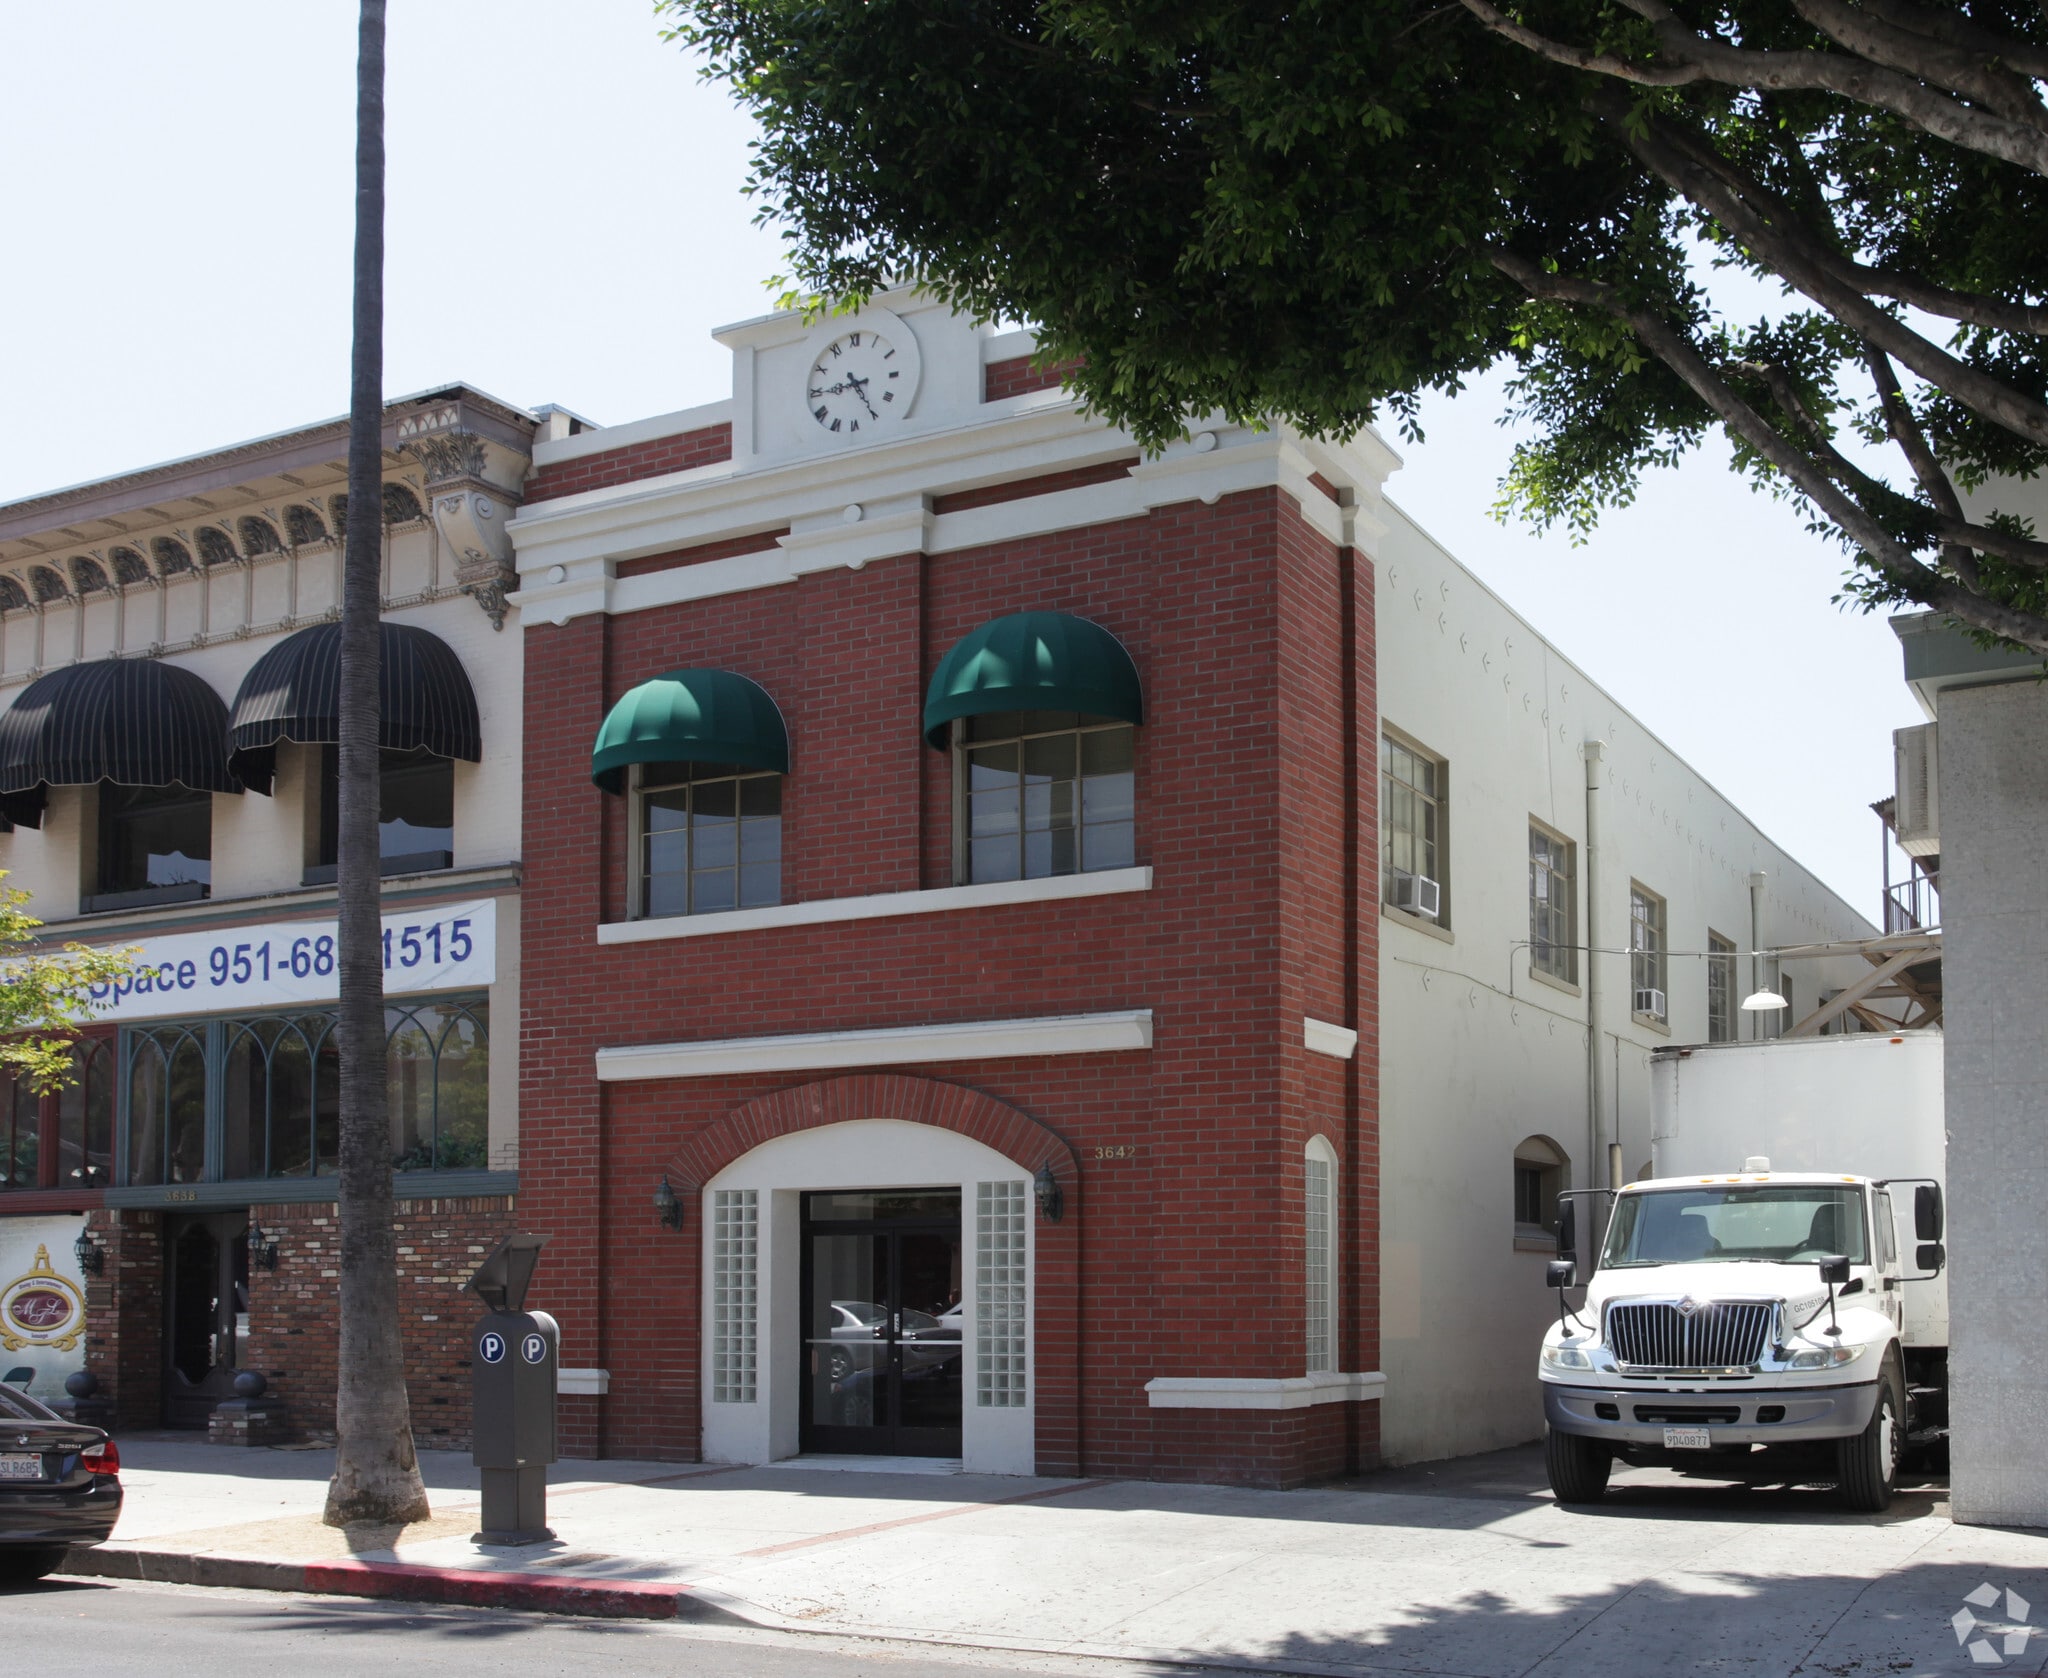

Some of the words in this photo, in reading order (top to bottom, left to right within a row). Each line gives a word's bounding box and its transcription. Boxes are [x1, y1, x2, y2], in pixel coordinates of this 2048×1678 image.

[209, 919, 473, 986] 951-681515
[1094, 1145, 1136, 1160] 3642
[486, 1337, 499, 1359] P
[528, 1338, 541, 1359] P
